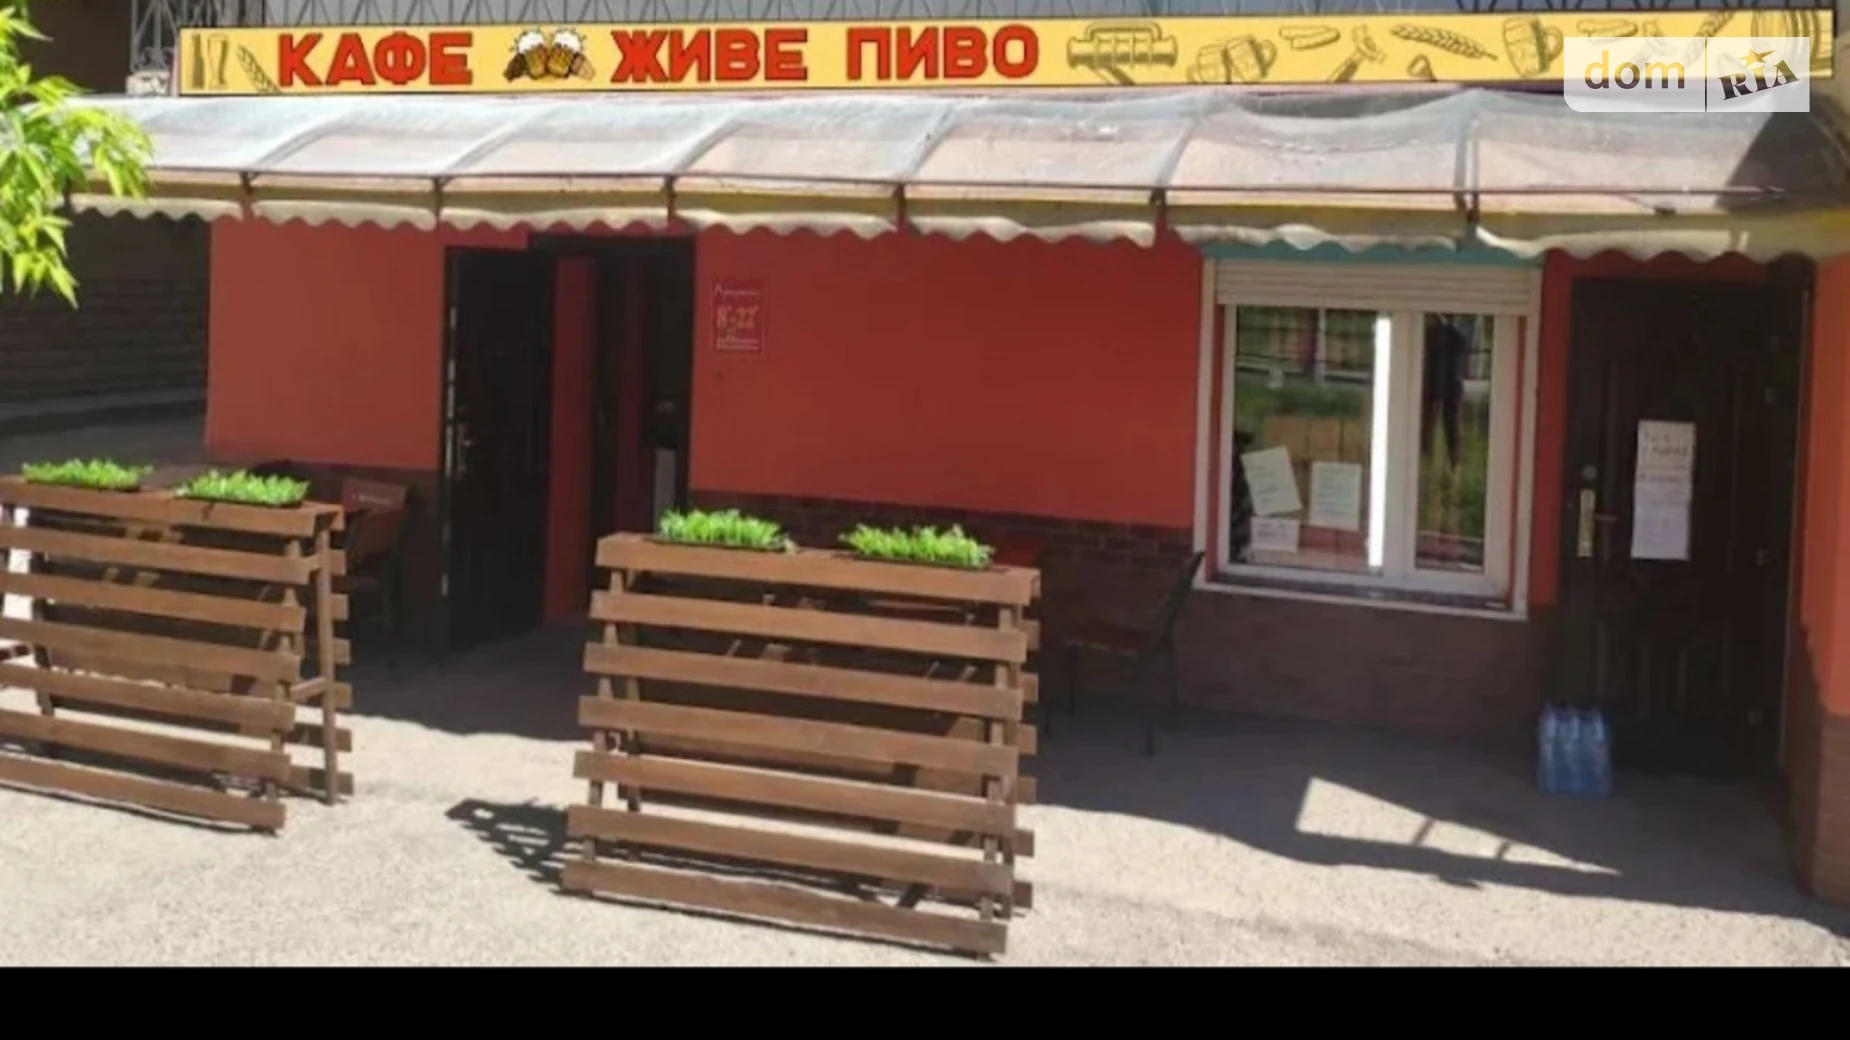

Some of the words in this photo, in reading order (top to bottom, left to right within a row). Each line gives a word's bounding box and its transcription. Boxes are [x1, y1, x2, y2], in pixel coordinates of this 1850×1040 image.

[276, 31, 474, 87] КАФЕ
[610, 28, 809, 83] ЖИВЕ
[845, 24, 1040, 80] ПИВО
